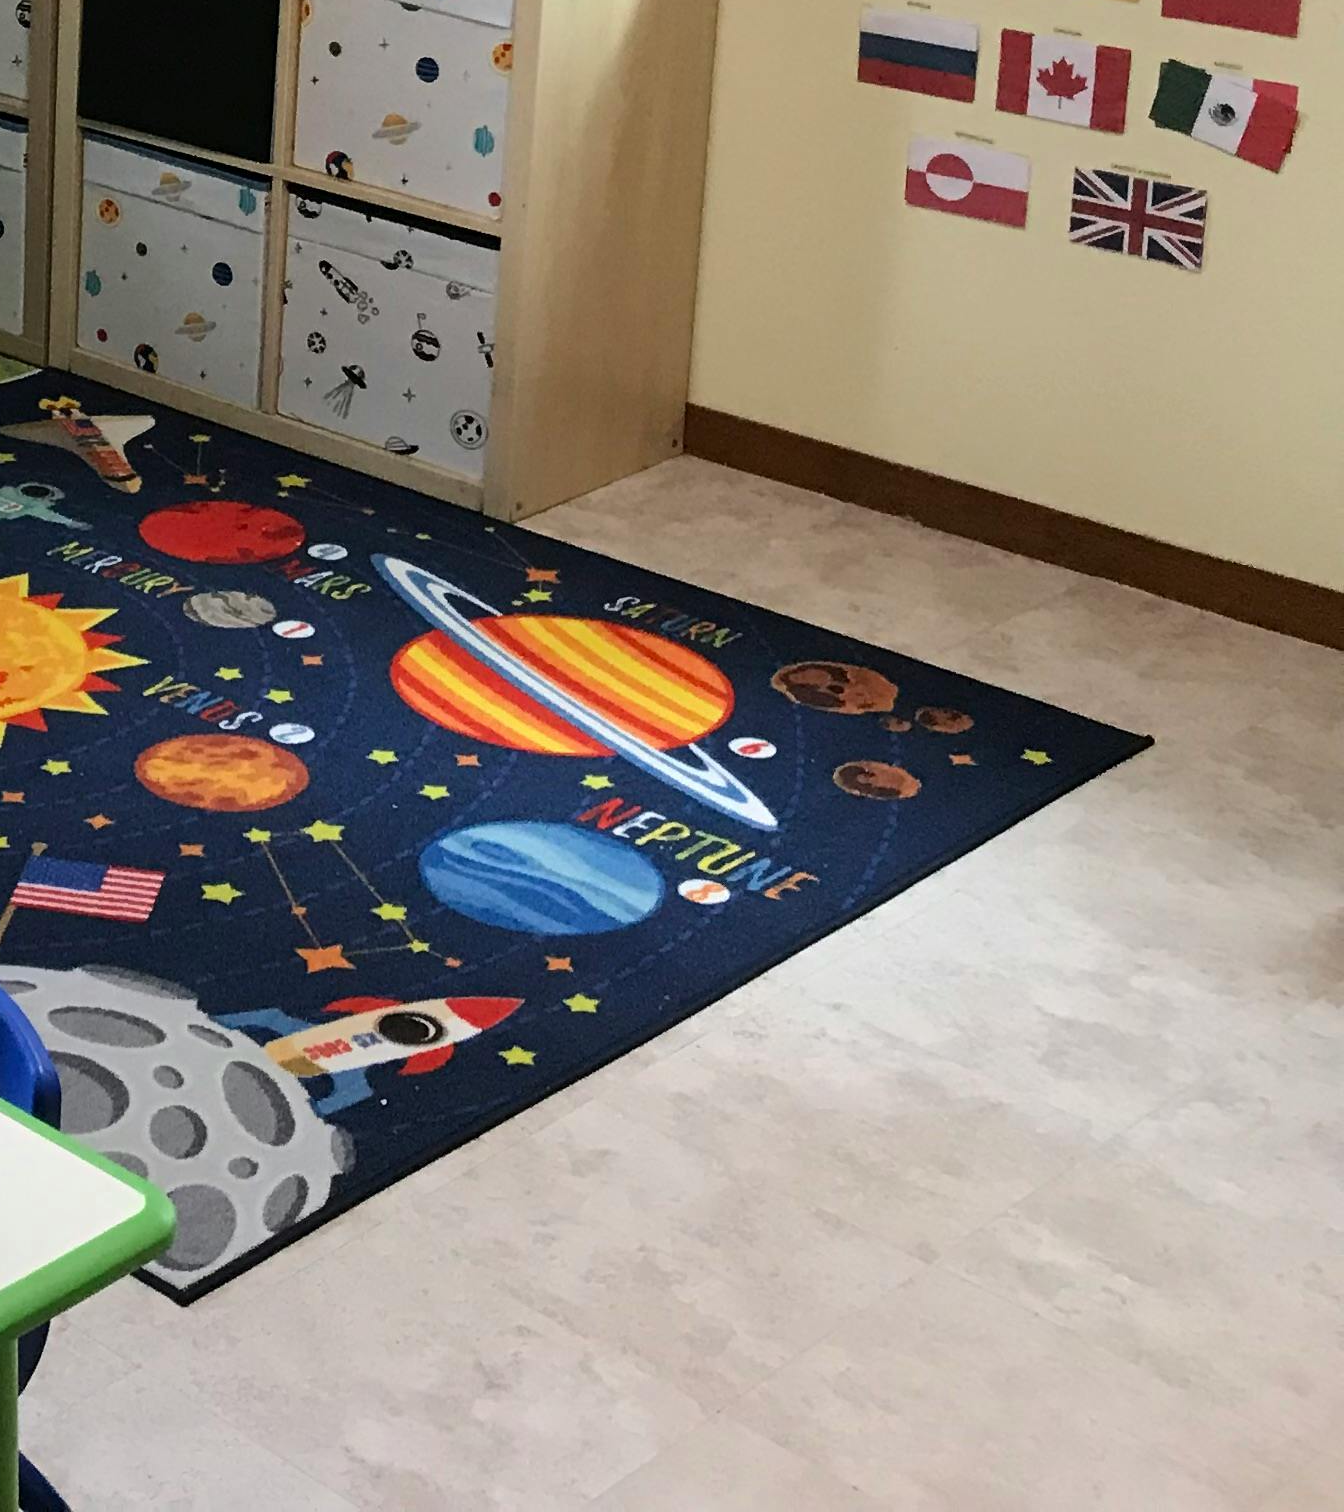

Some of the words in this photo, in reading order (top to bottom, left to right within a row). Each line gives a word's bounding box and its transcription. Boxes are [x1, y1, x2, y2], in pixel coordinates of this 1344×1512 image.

[47, 542, 194, 598] MERCURY
[265, 560, 372, 600] MARS
[604, 597, 743, 648] SATURN
[143, 676, 263, 729] VENUS
[576, 797, 820, 900] NEPTUNE
[685, 883, 725, 902] 8
